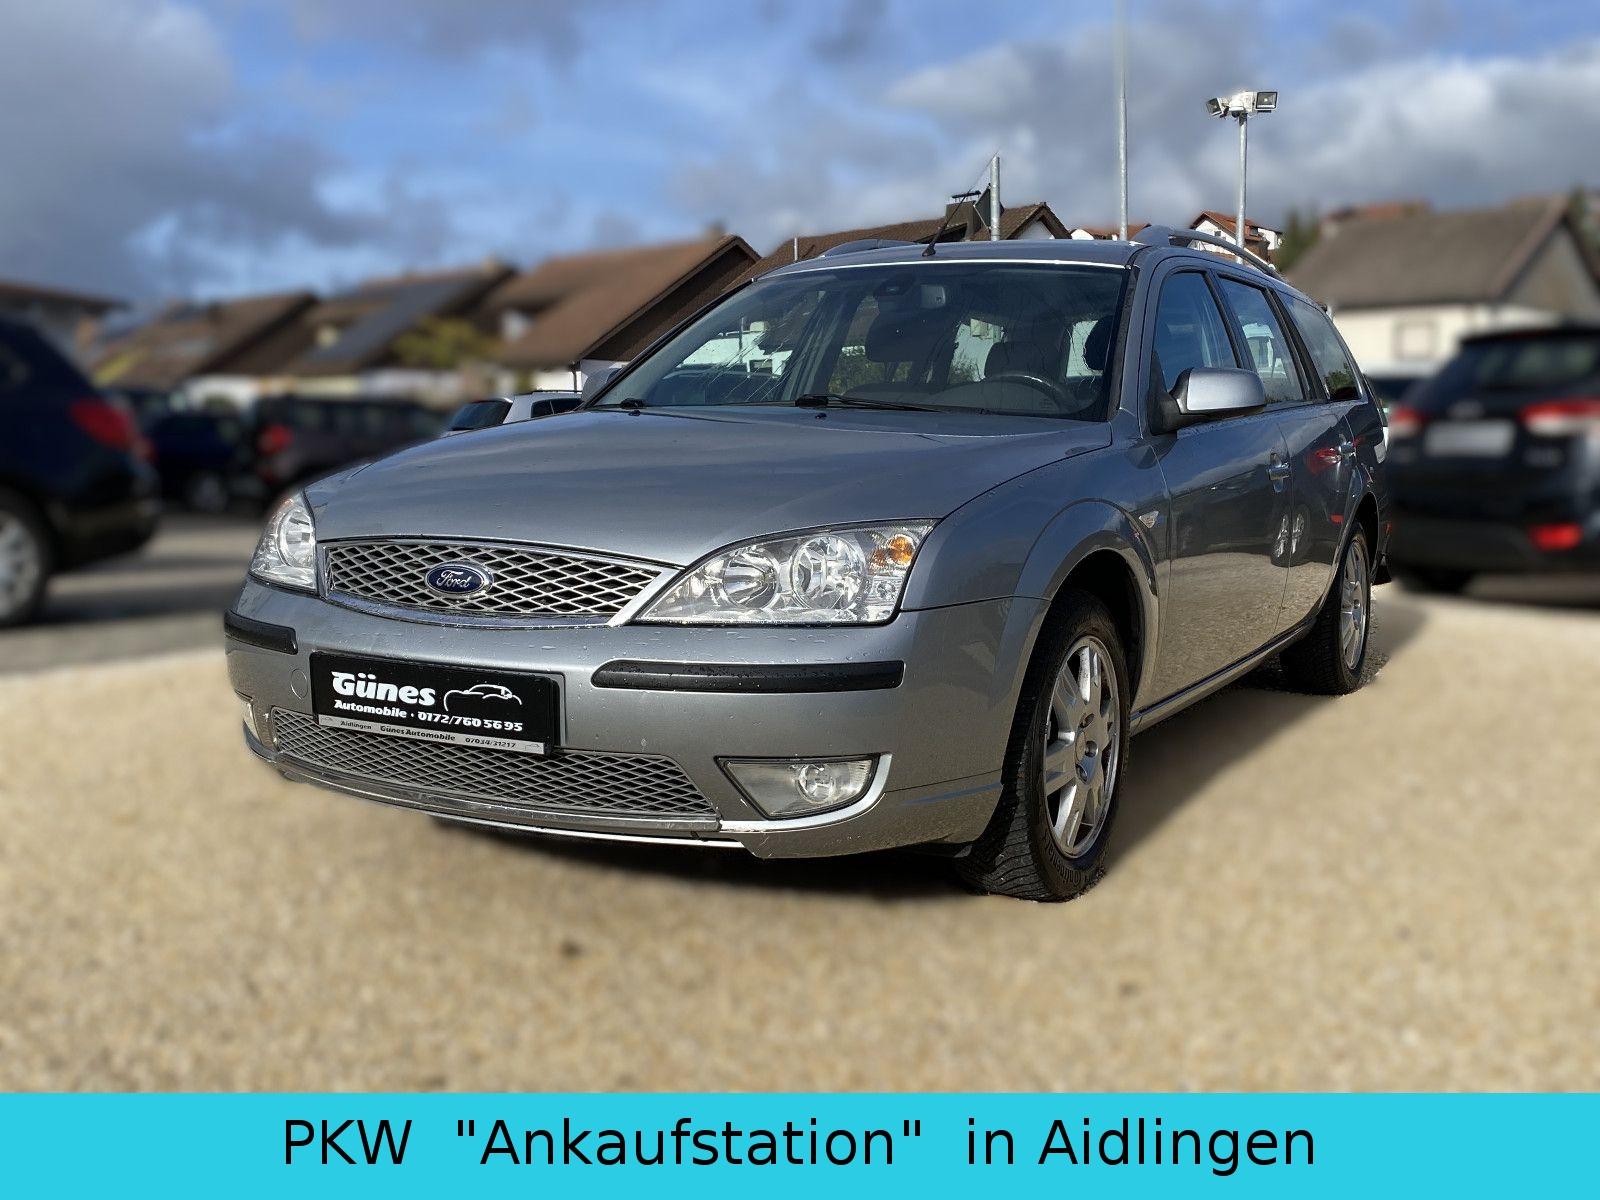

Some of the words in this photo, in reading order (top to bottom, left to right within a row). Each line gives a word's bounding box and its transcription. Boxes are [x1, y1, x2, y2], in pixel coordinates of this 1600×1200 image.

[436, 569, 472, 588] Ford
[331, 671, 436, 706] Günes
[334, 699, 408, 718] Automobile
[340, 720, 372, 731] Aidlingen
